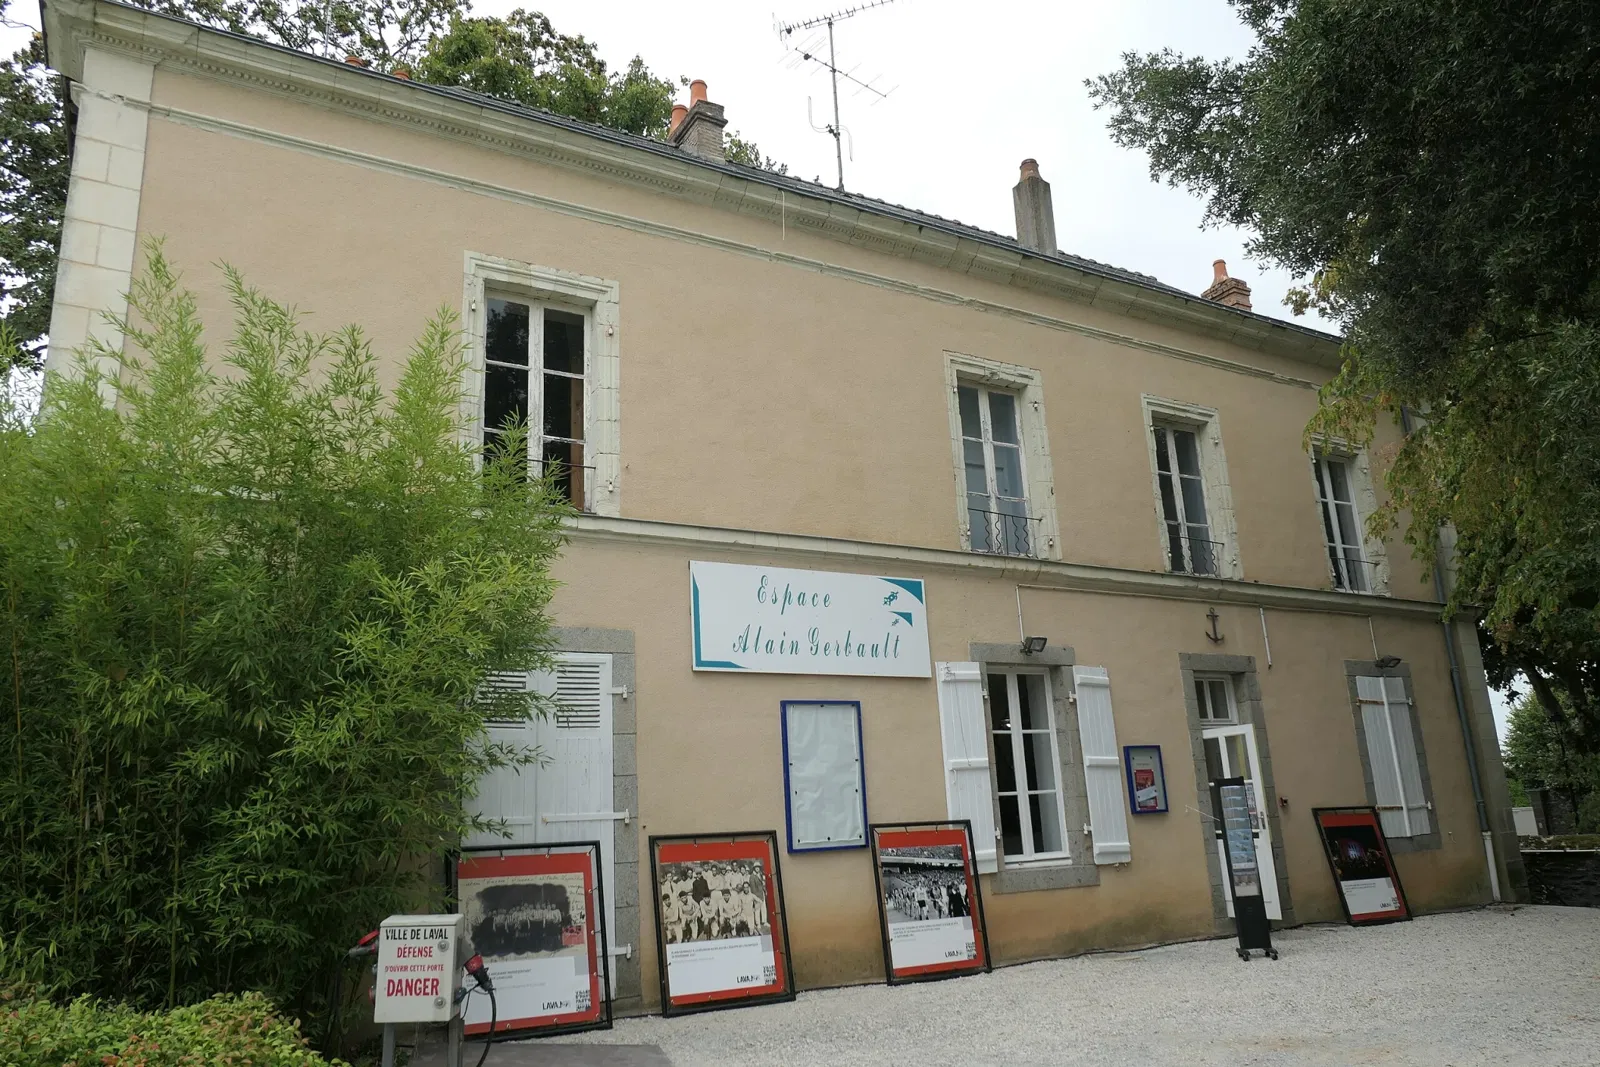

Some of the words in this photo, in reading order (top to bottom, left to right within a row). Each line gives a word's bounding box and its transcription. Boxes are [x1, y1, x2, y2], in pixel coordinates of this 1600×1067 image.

[757, 574, 831, 615] Espace
[732, 623, 800, 656] Alain
[807, 626, 900, 659] Gerbault
[385, 928, 408, 940] VILLE
[410, 928, 421, 940] DE
[423, 928, 448, 940] LAVAL
[396, 943, 433, 958] DÉFENSE
[385, 965, 409, 973] D'OUVRIR
[409, 964, 426, 972] CETTE
[426, 964, 444, 972] PORTE
[386, 978, 440, 997] DANGER
